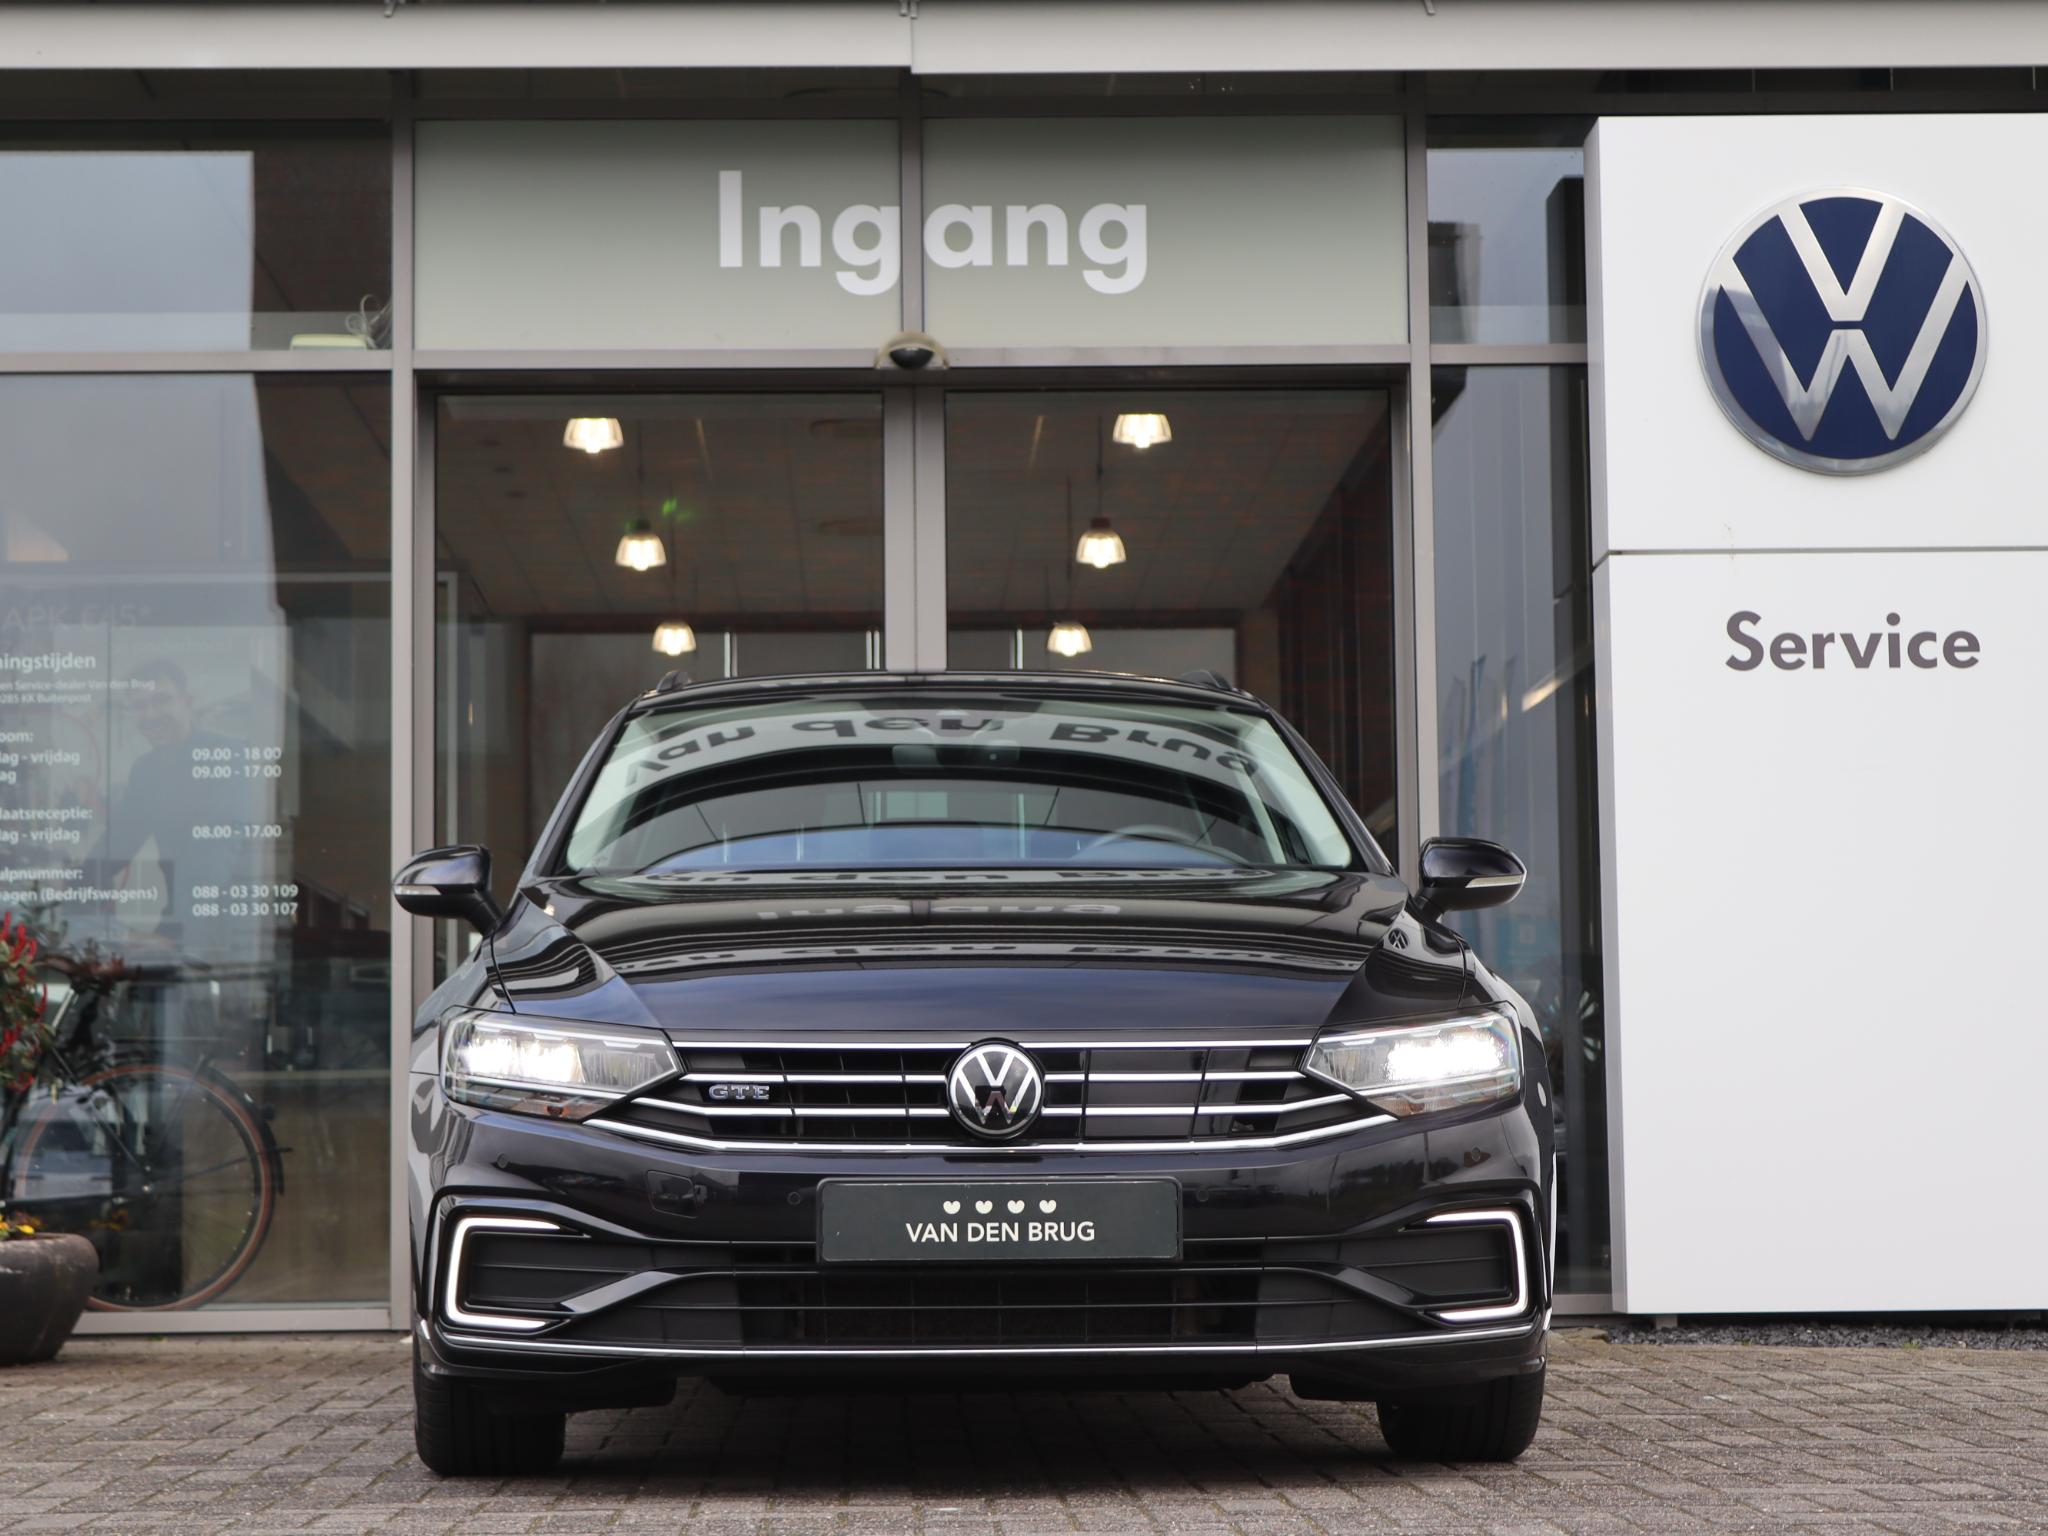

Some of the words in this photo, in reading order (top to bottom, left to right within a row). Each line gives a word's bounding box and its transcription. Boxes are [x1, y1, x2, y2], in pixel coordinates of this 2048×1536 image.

[719, 169, 1148, 297] Ingang
[1725, 610, 1980, 672] Service
[30, 749, 80, 768] vrijdag
[192, 748, 231, 761] 09.00
[192, 766, 231, 779] 09.00
[30, 827, 80, 845] vrijdag
[192, 825, 231, 838] 08.00
[244, 825, 282, 838] 17.00
[192, 886, 219, 899] 088
[230, 885, 248, 898] 03
[251, 885, 270, 898] 30
[272, 884, 299, 898] 109
[192, 904, 219, 917] 088
[230, 903, 248, 916] 03
[251, 903, 270, 916] 30
[272, 902, 299, 916] 107
[708, 1083, 770, 1101] GTE
[905, 1222, 958, 1244] VAN
[967, 1221, 1020, 1243] DEN
[1028, 1220, 1096, 1242] BRUG
